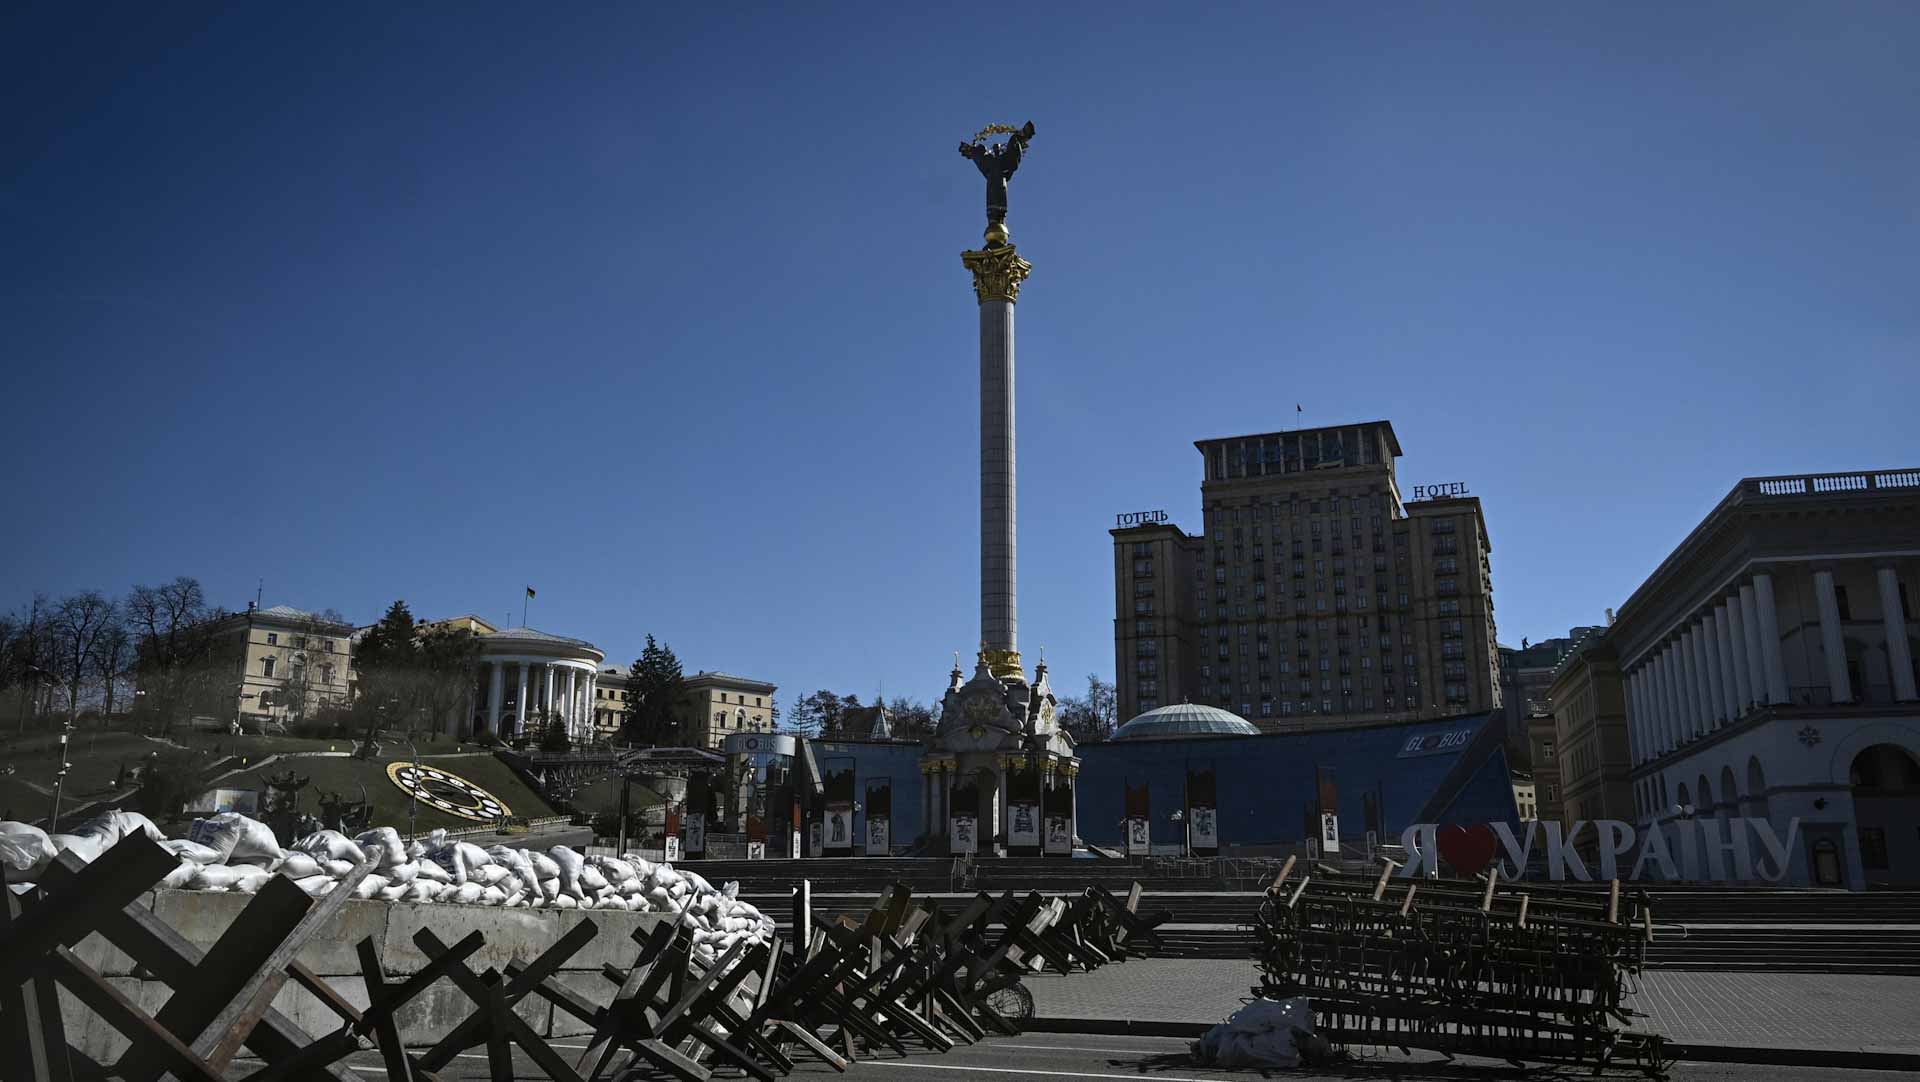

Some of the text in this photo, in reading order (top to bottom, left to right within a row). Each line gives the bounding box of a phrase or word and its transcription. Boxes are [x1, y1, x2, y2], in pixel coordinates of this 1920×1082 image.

[1413, 482, 1470, 498] HOTEL
[1116, 510, 1168, 526] ГОТЕЛЬ
[737, 738, 777, 751] GLOBUS
[1405, 729, 1471, 751] GLOBUS
[1400, 823, 1439, 880] Я
